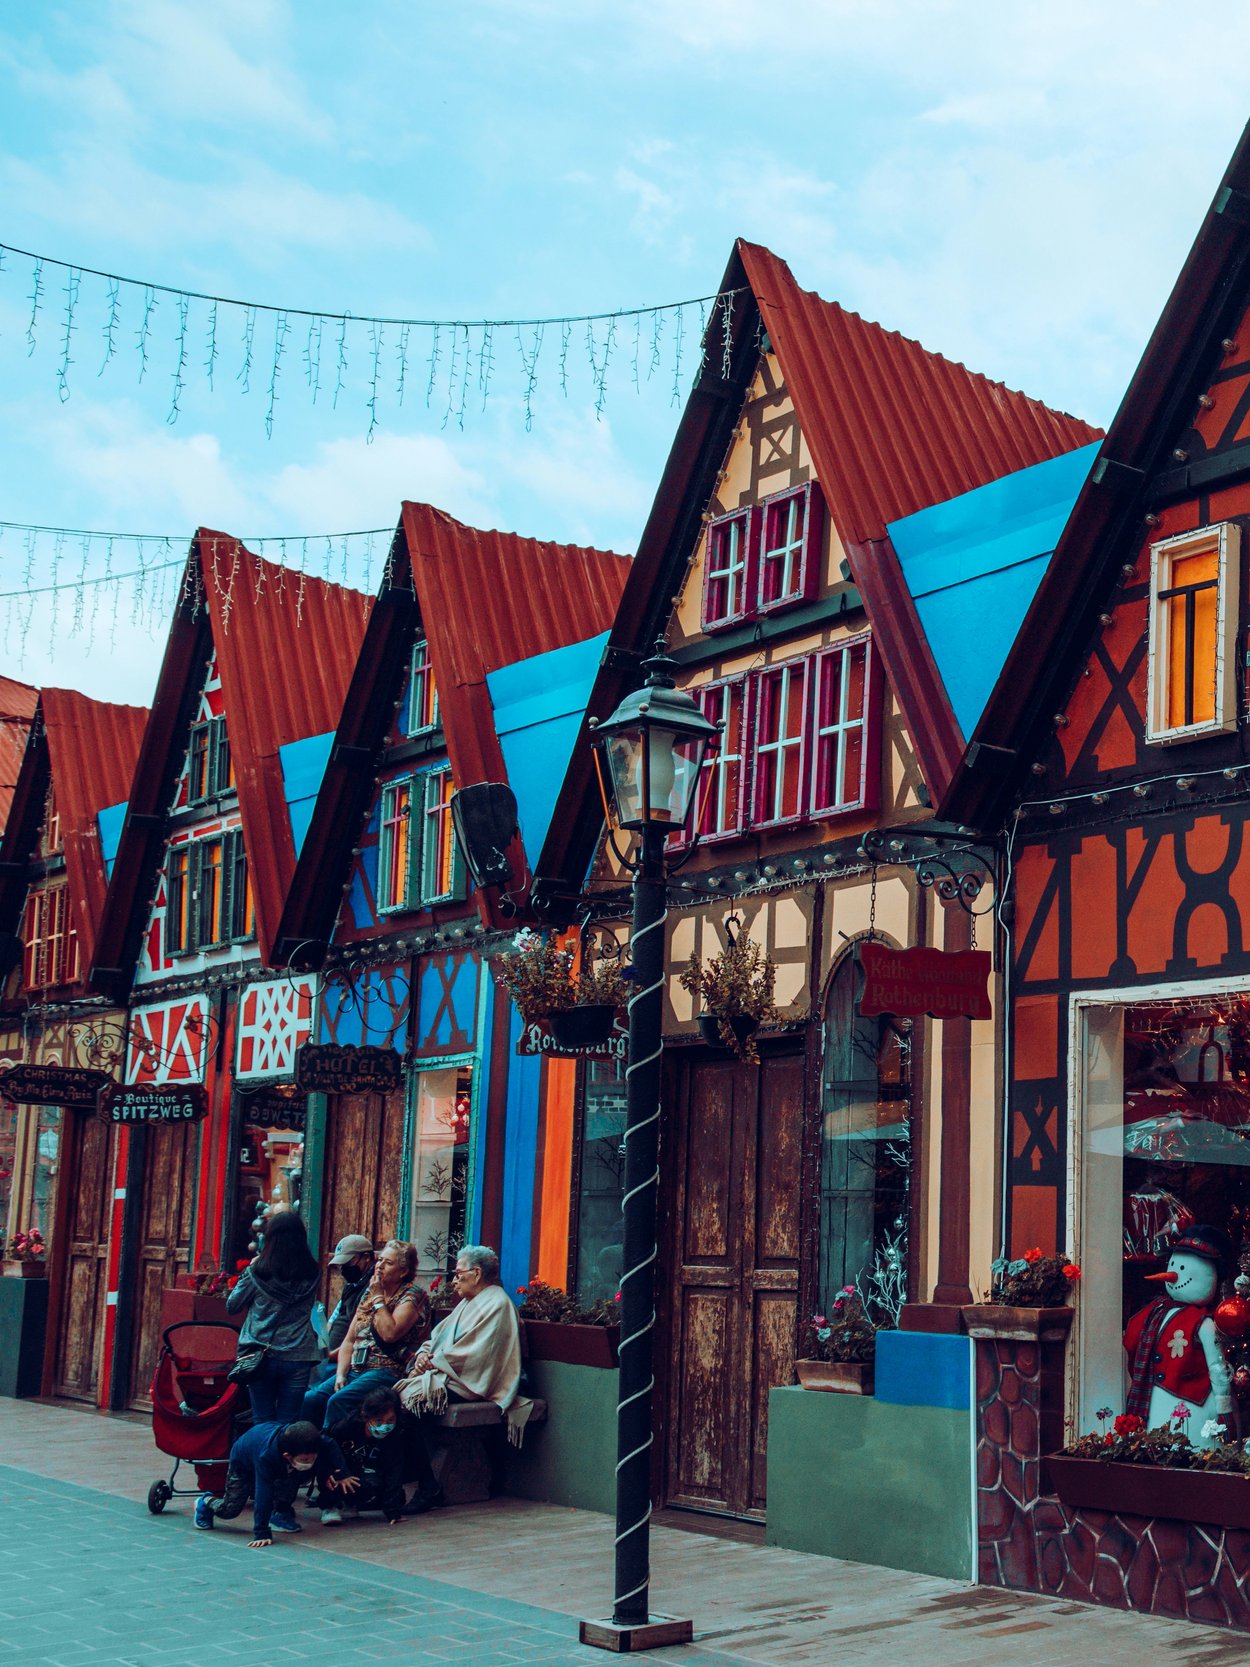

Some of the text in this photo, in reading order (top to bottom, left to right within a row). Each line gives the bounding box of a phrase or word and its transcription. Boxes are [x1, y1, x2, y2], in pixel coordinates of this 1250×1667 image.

[316, 1056, 380, 1074] HOTEL
[23, 1069, 87, 1081] CHRISTMAS
[124, 1093, 177, 1106] Boutique
[112, 1103, 193, 1120] SPITZWEG
